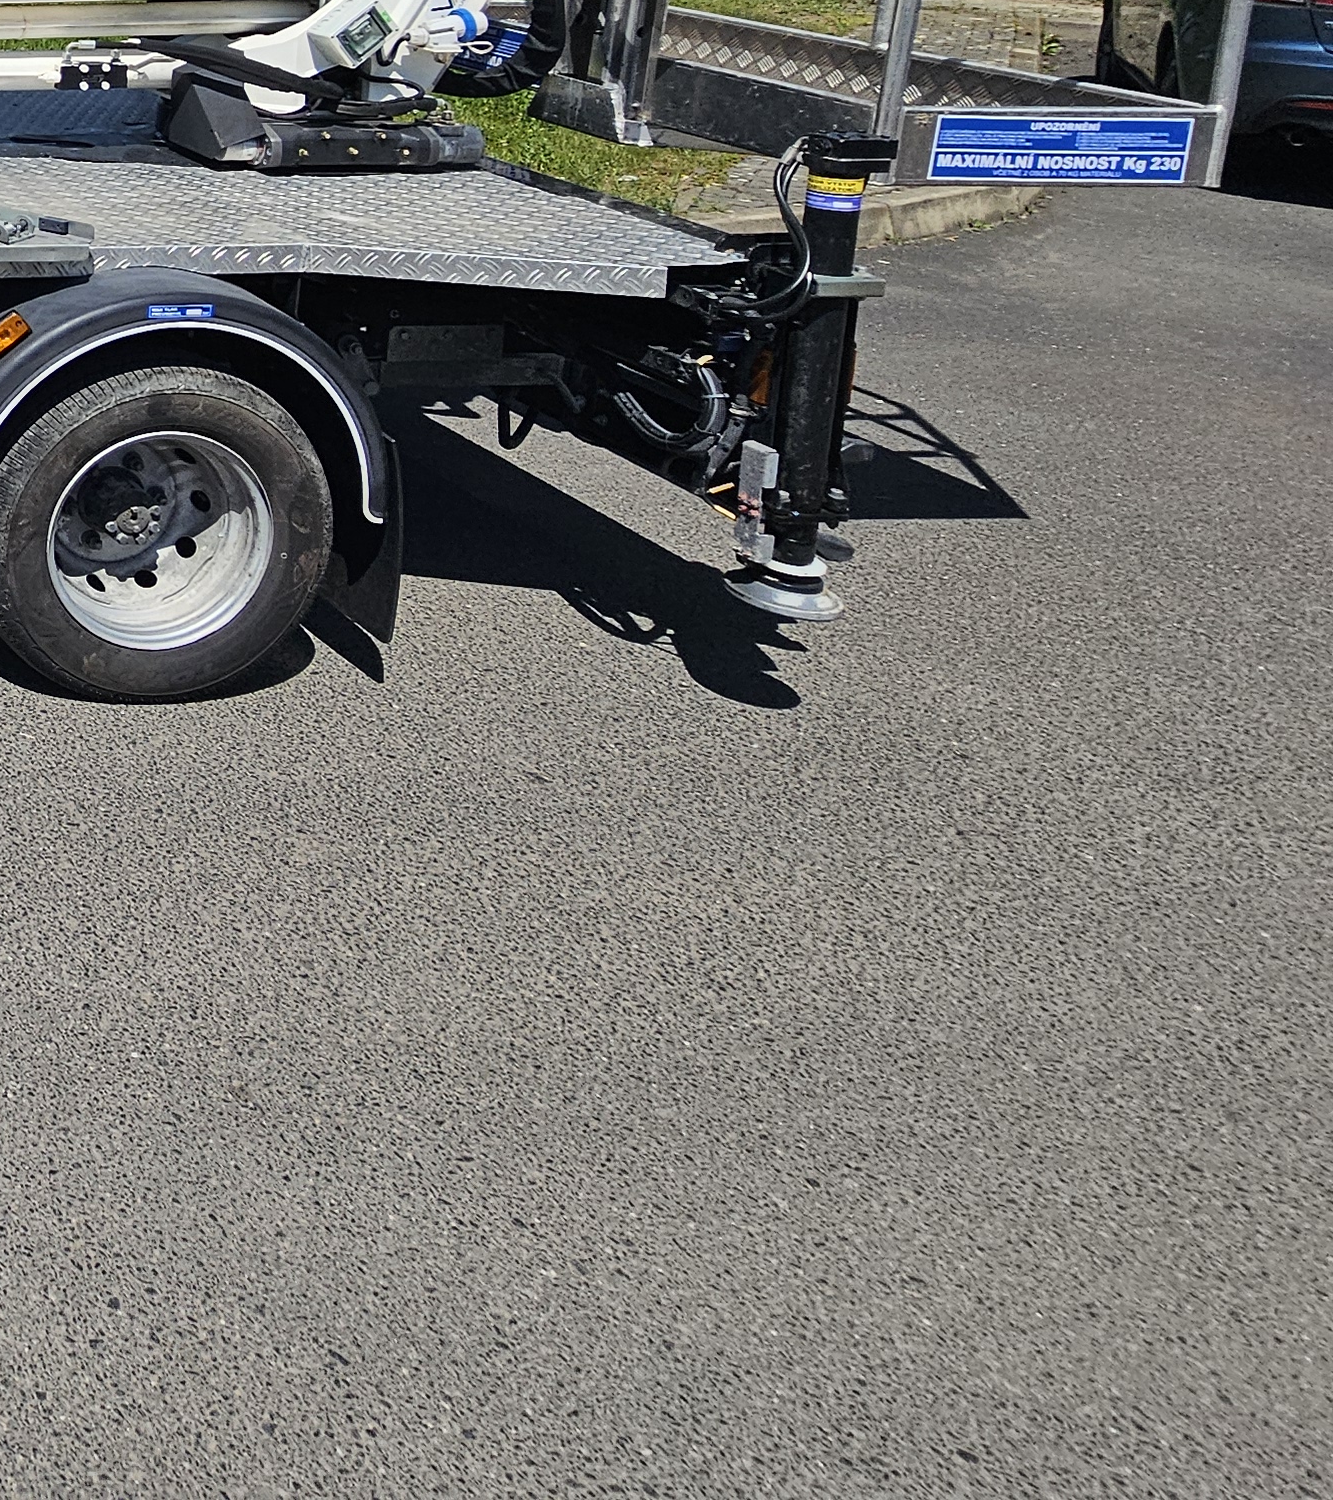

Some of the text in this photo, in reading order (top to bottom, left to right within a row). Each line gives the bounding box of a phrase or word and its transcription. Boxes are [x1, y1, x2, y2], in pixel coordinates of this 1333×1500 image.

[936, 151, 1182, 174] MAXIMÁLNÍ NOSNOST Kg 230
